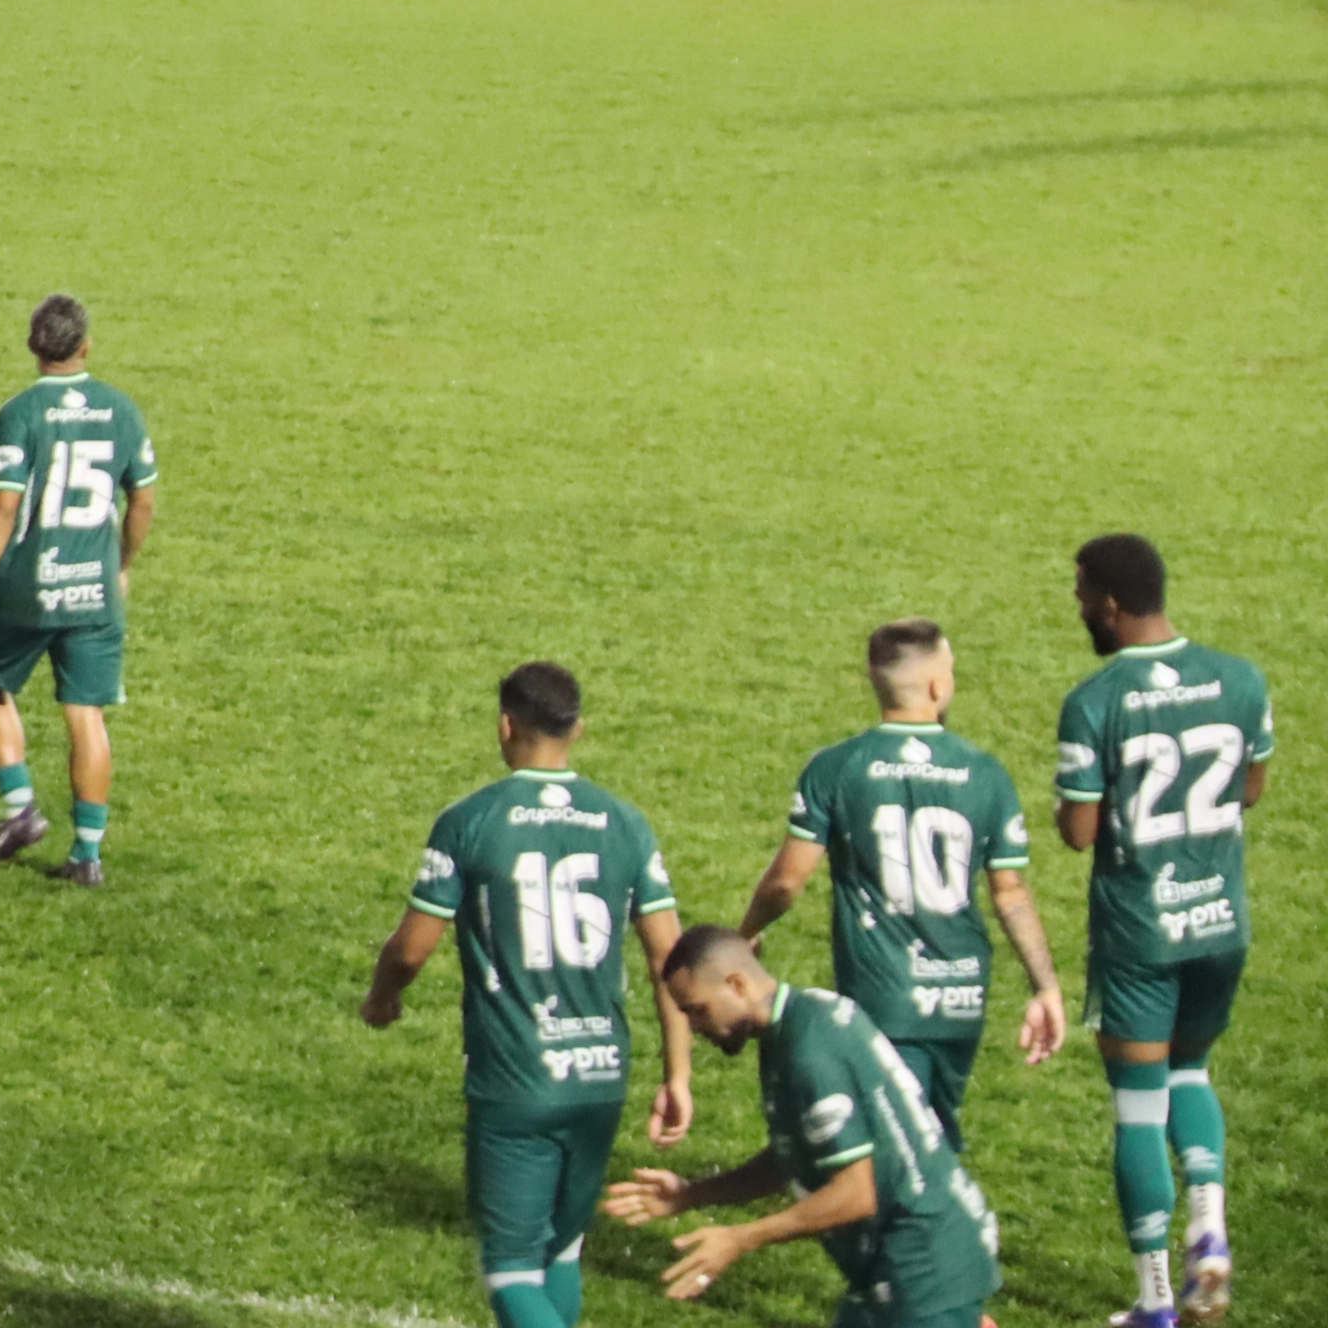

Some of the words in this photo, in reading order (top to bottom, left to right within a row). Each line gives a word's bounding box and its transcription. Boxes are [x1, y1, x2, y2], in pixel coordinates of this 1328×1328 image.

[40, 440, 114, 529] 15
[64, 583, 105, 602] DTC
[1122, 679, 1221, 712] GrupoCereal
[868, 760, 969, 784] GrupoCereal
[1122, 723, 1243, 846] 22
[509, 805, 608, 830] GrupoCereal
[871, 804, 972, 915] 10
[512, 851, 611, 970] 16
[1190, 898, 1234, 926] DTC
[943, 985, 984, 1007] DTC
[573, 1045, 620, 1069] DTC
